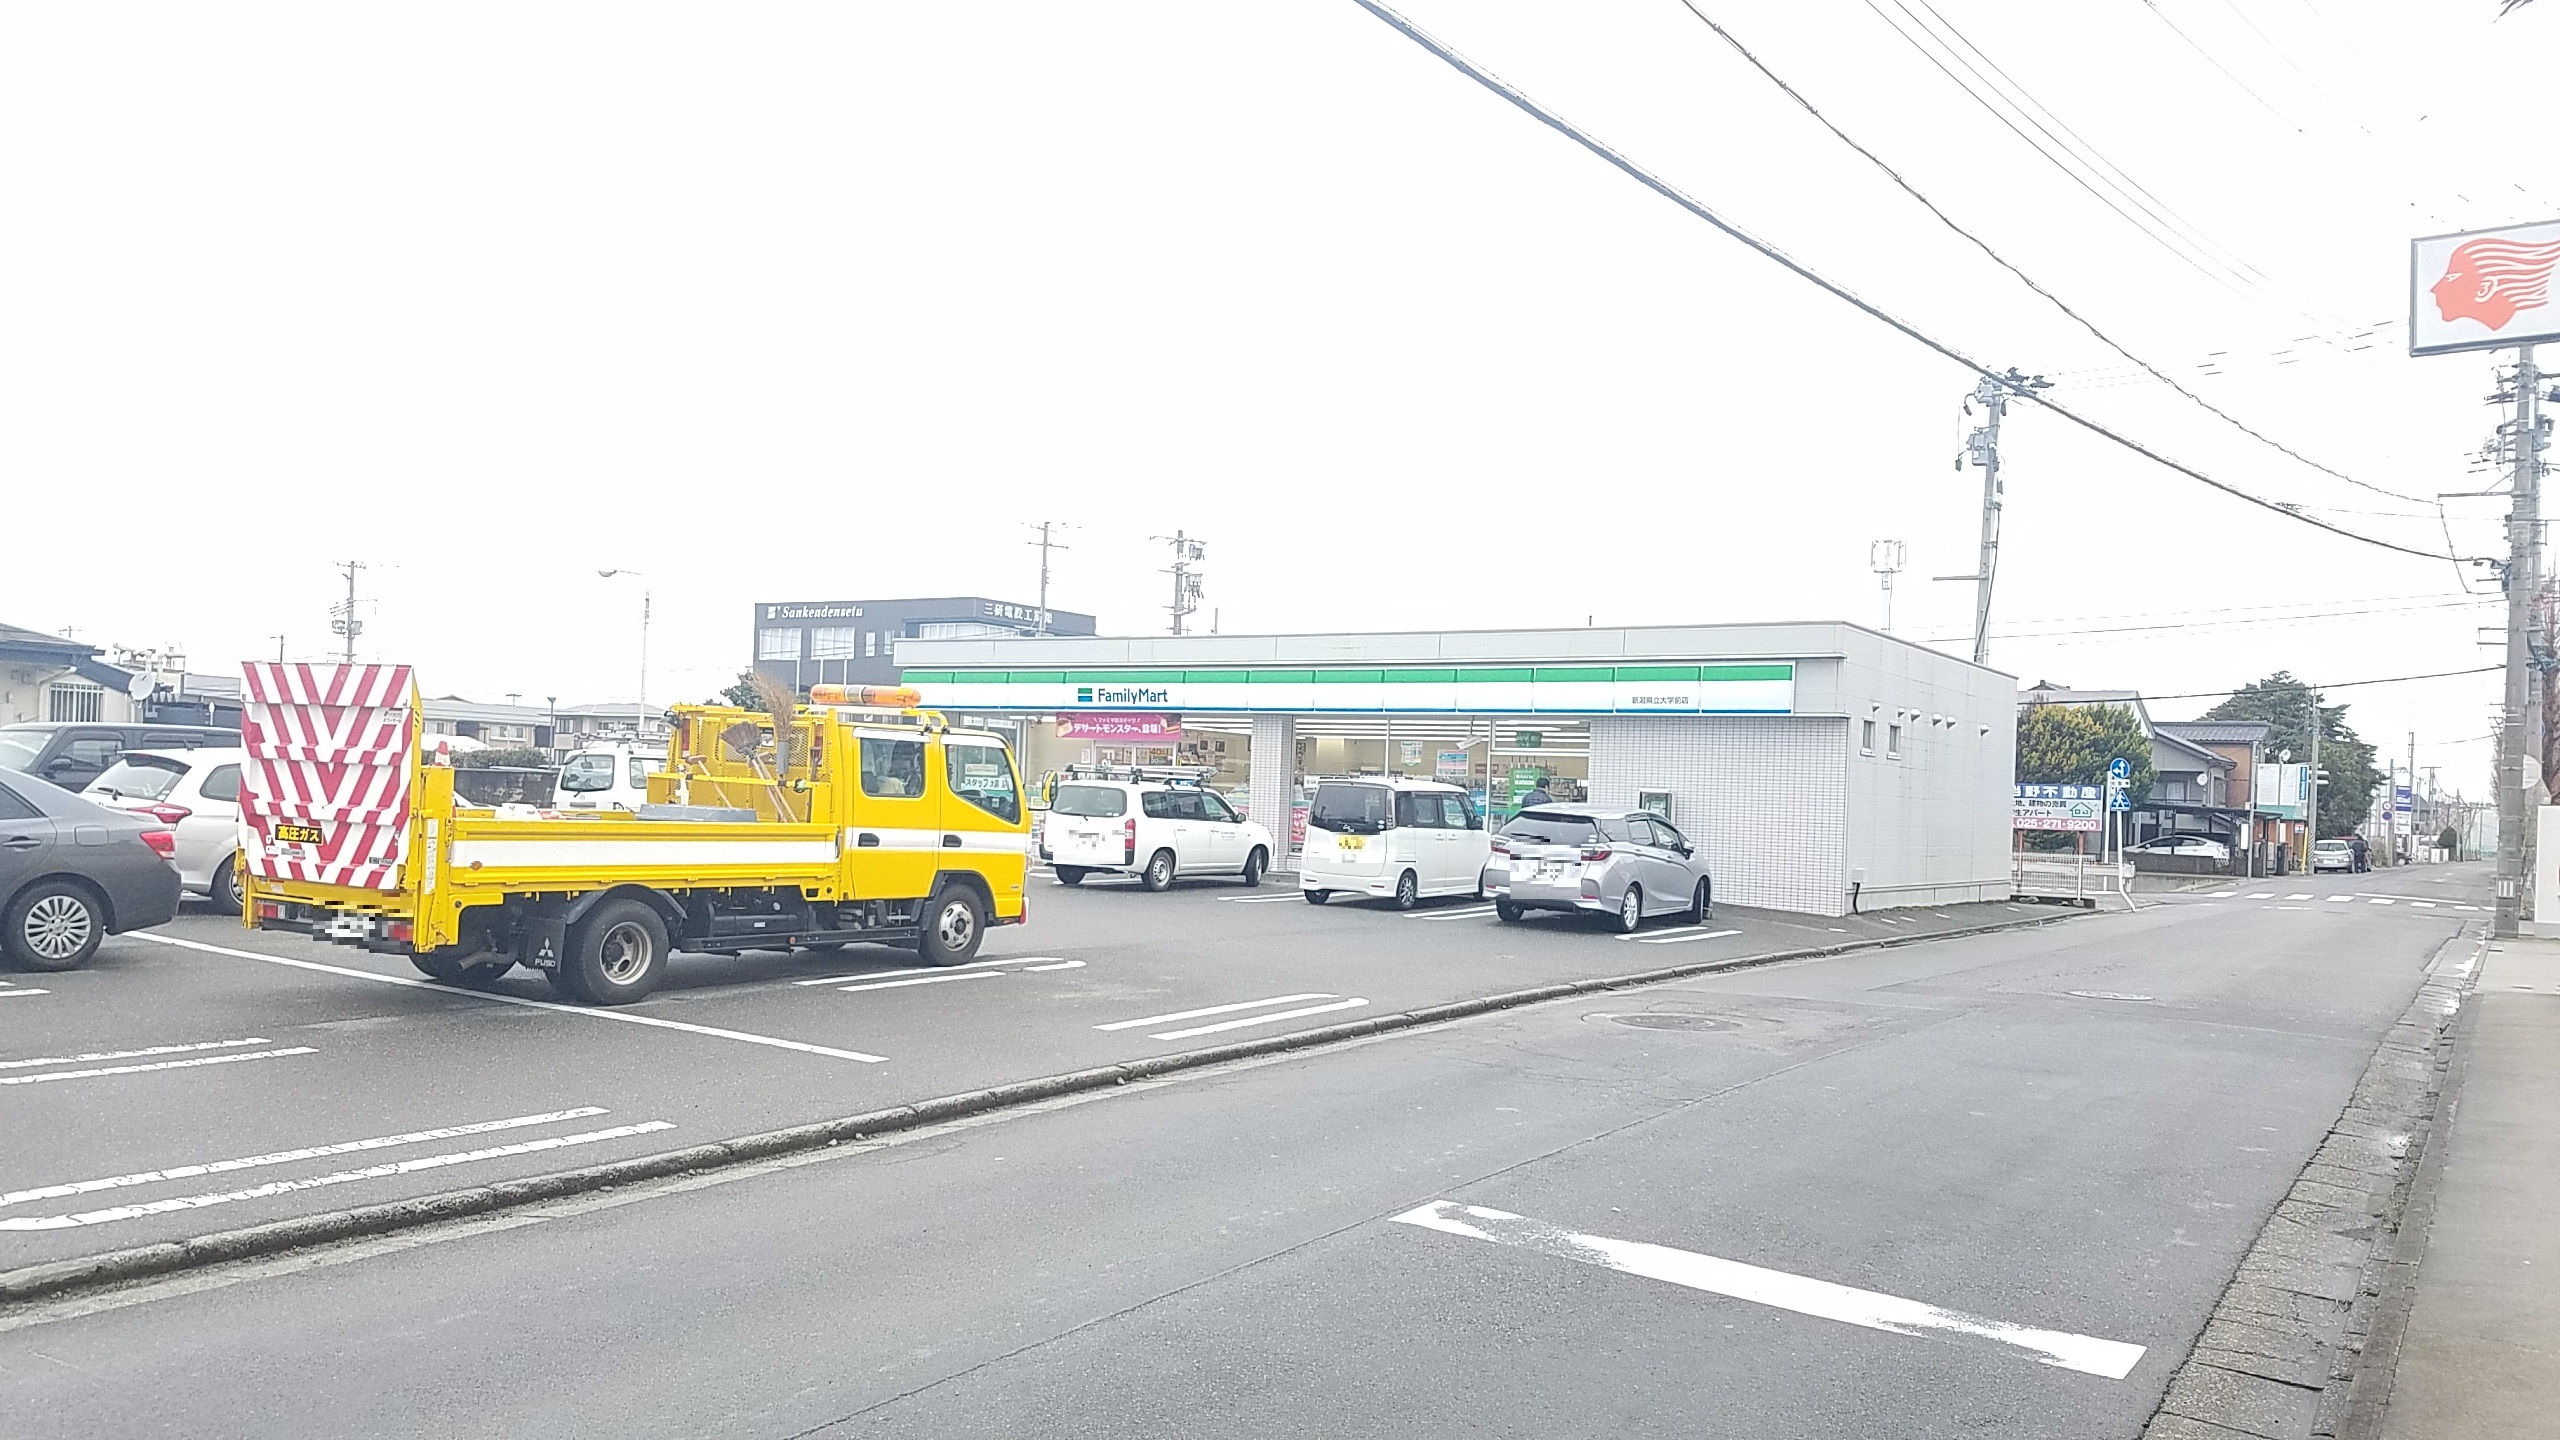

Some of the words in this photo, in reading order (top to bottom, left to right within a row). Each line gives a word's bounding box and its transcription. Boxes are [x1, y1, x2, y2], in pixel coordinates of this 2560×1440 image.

[782, 605, 863, 618] Sankendensetu
[1098, 688, 1168, 704] FamilyMart
[1632, 696, 1689, 704] 新潟県立大学前店
[2013, 800, 2067, 808] 地、建物の売買
[278, 826, 319, 842] 高圧ガス
[534, 958, 556, 967] FUSO
